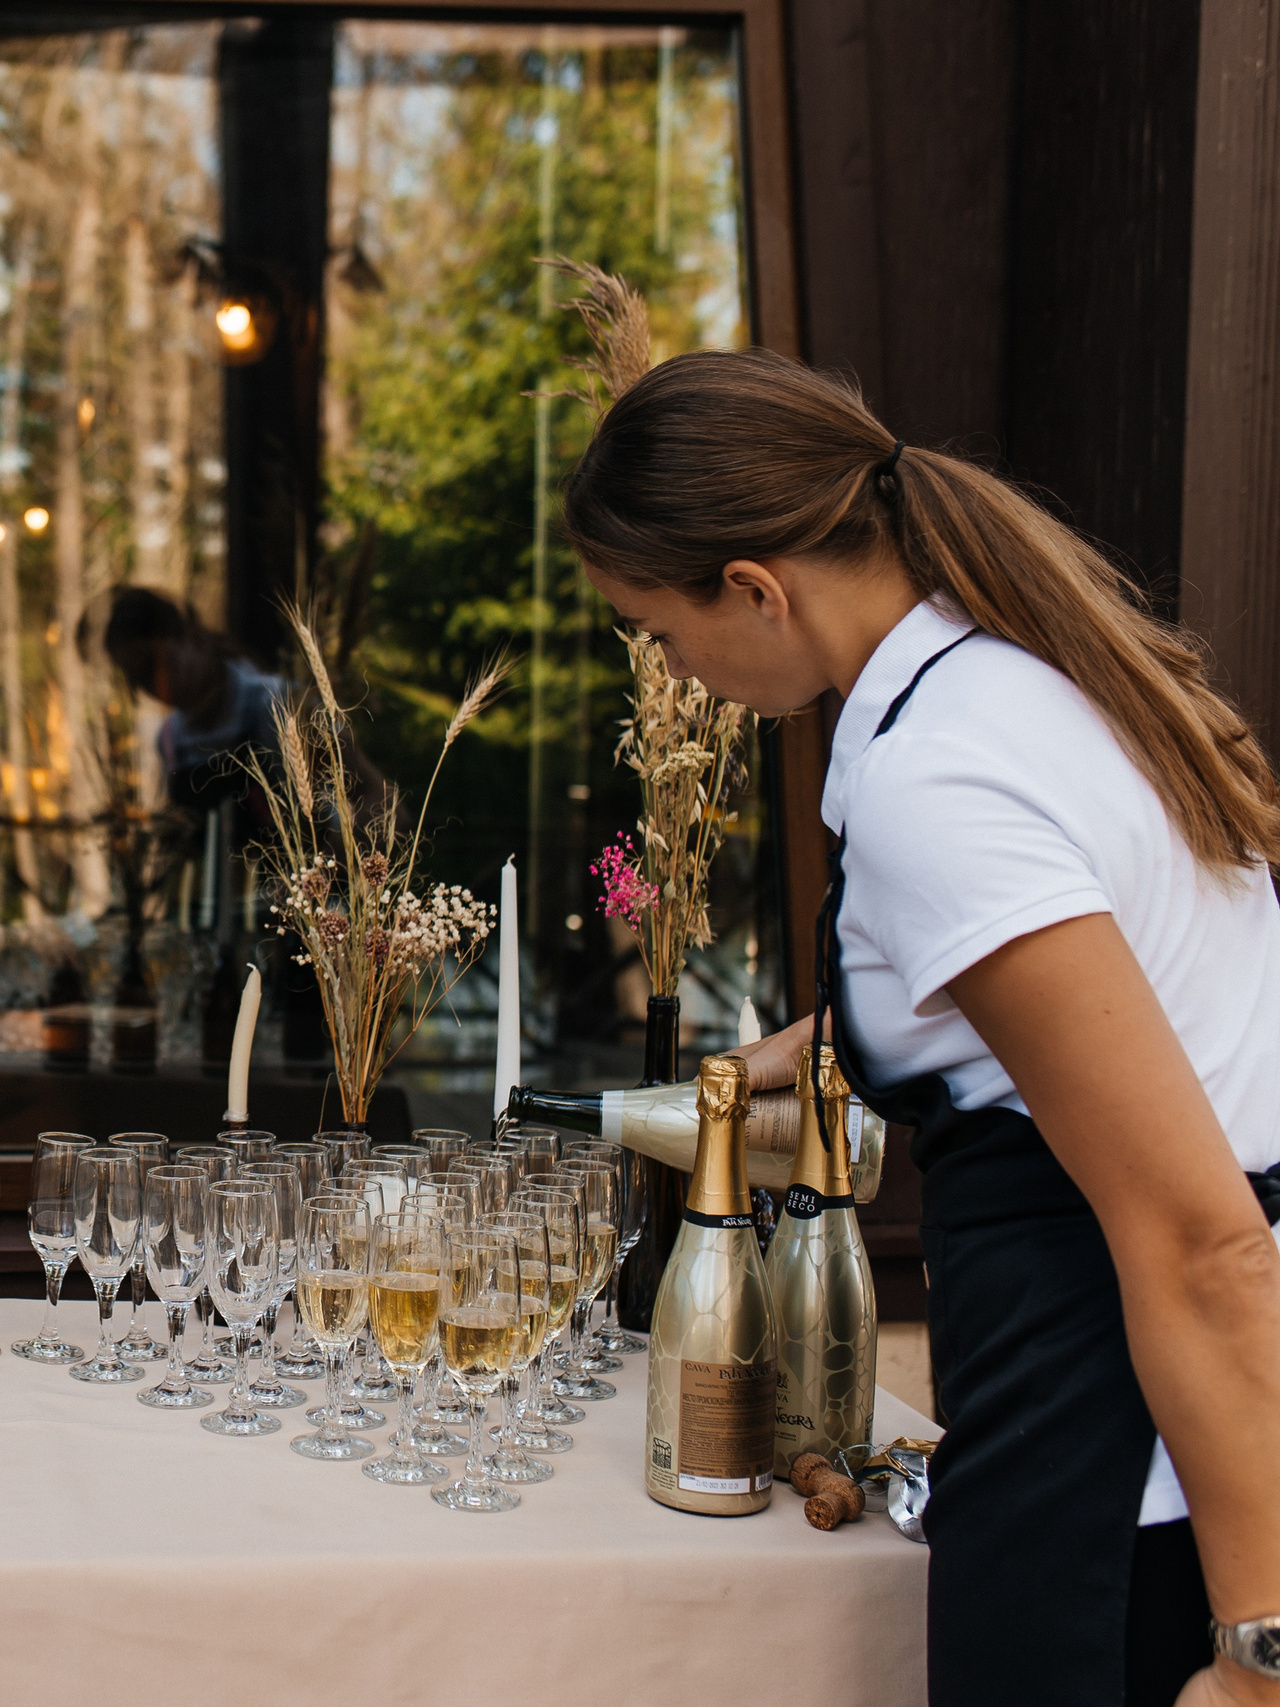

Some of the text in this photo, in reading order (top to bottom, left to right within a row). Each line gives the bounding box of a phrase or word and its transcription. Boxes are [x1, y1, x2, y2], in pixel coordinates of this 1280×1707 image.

[789, 1190, 815, 1204] SEMI
[787, 1199, 815, 1212] SECO
[685, 1363, 711, 1374] CAVA
